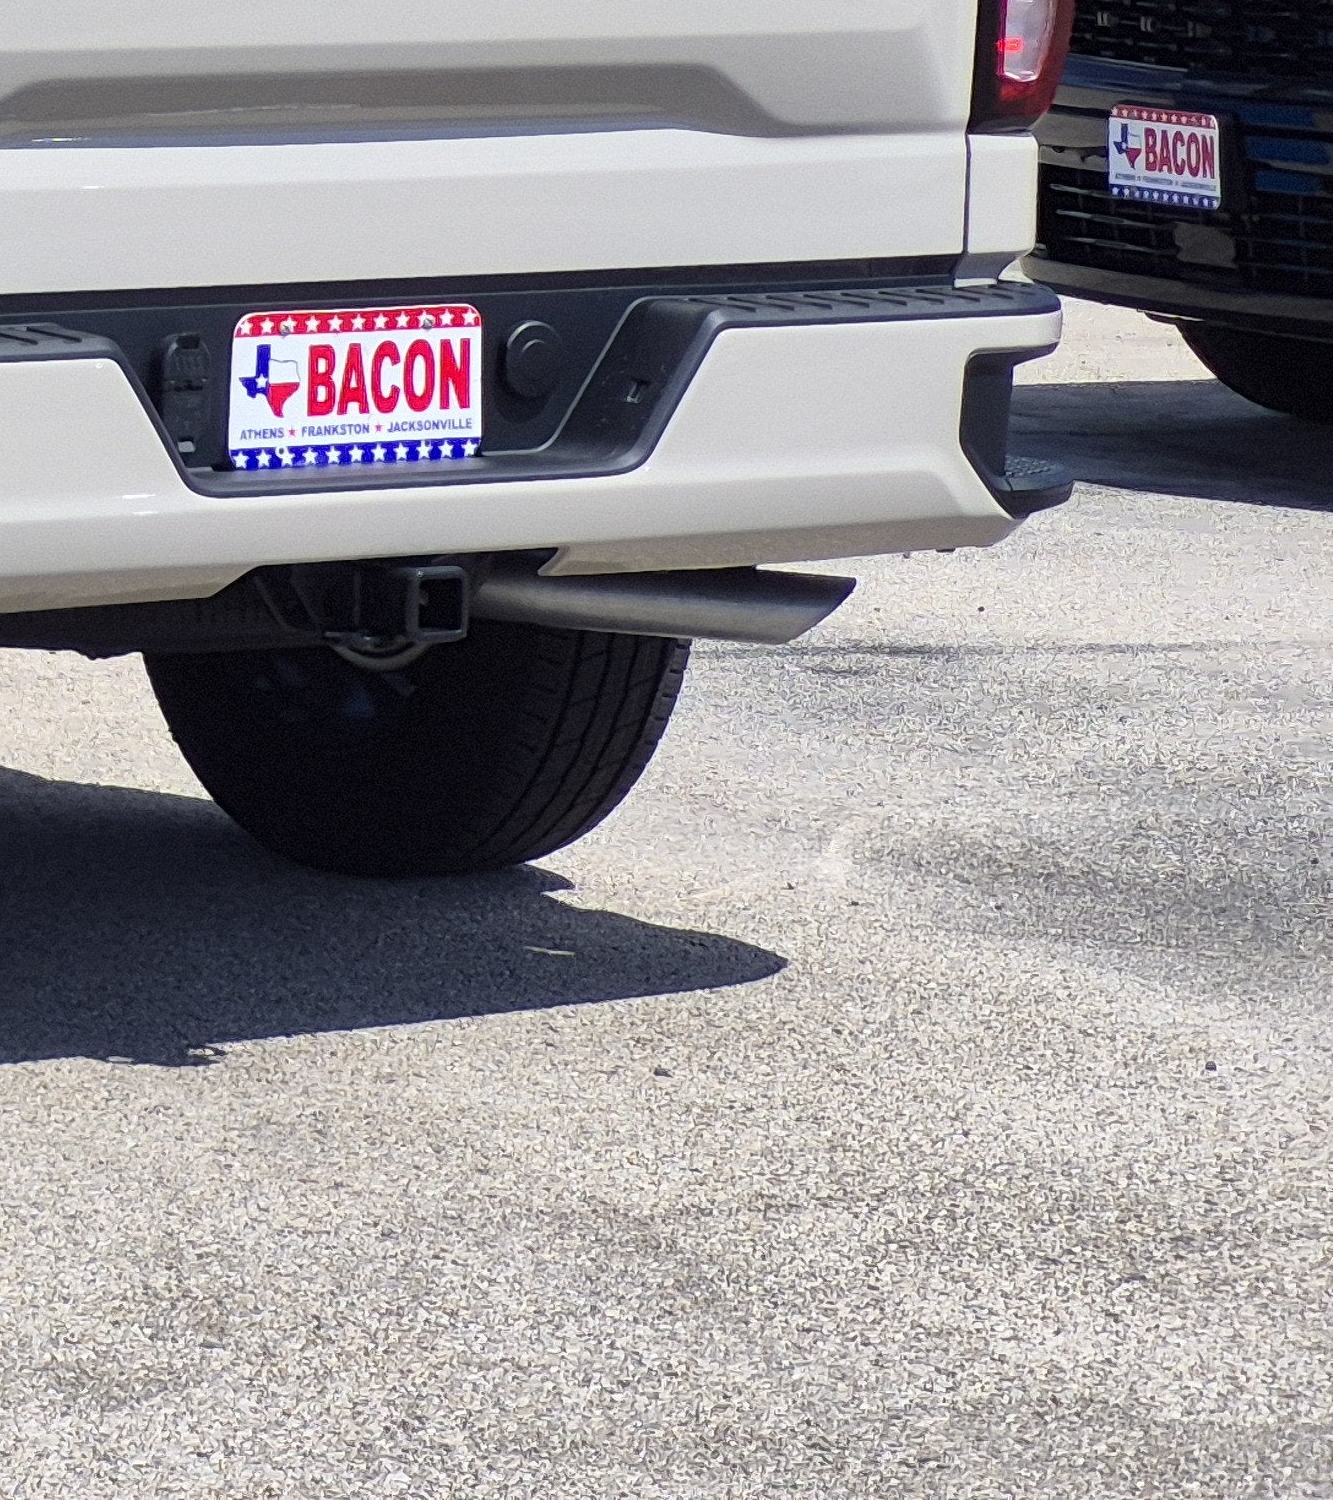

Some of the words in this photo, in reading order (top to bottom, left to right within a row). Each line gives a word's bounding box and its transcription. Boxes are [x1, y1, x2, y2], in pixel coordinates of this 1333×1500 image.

[1144, 127, 1215, 179] BACON
[307, 338, 471, 417] BACON
[240, 427, 284, 440] ATHENS
[301, 423, 370, 437] FRANKSTON
[387, 418, 472, 432] JACKSONVILLE
